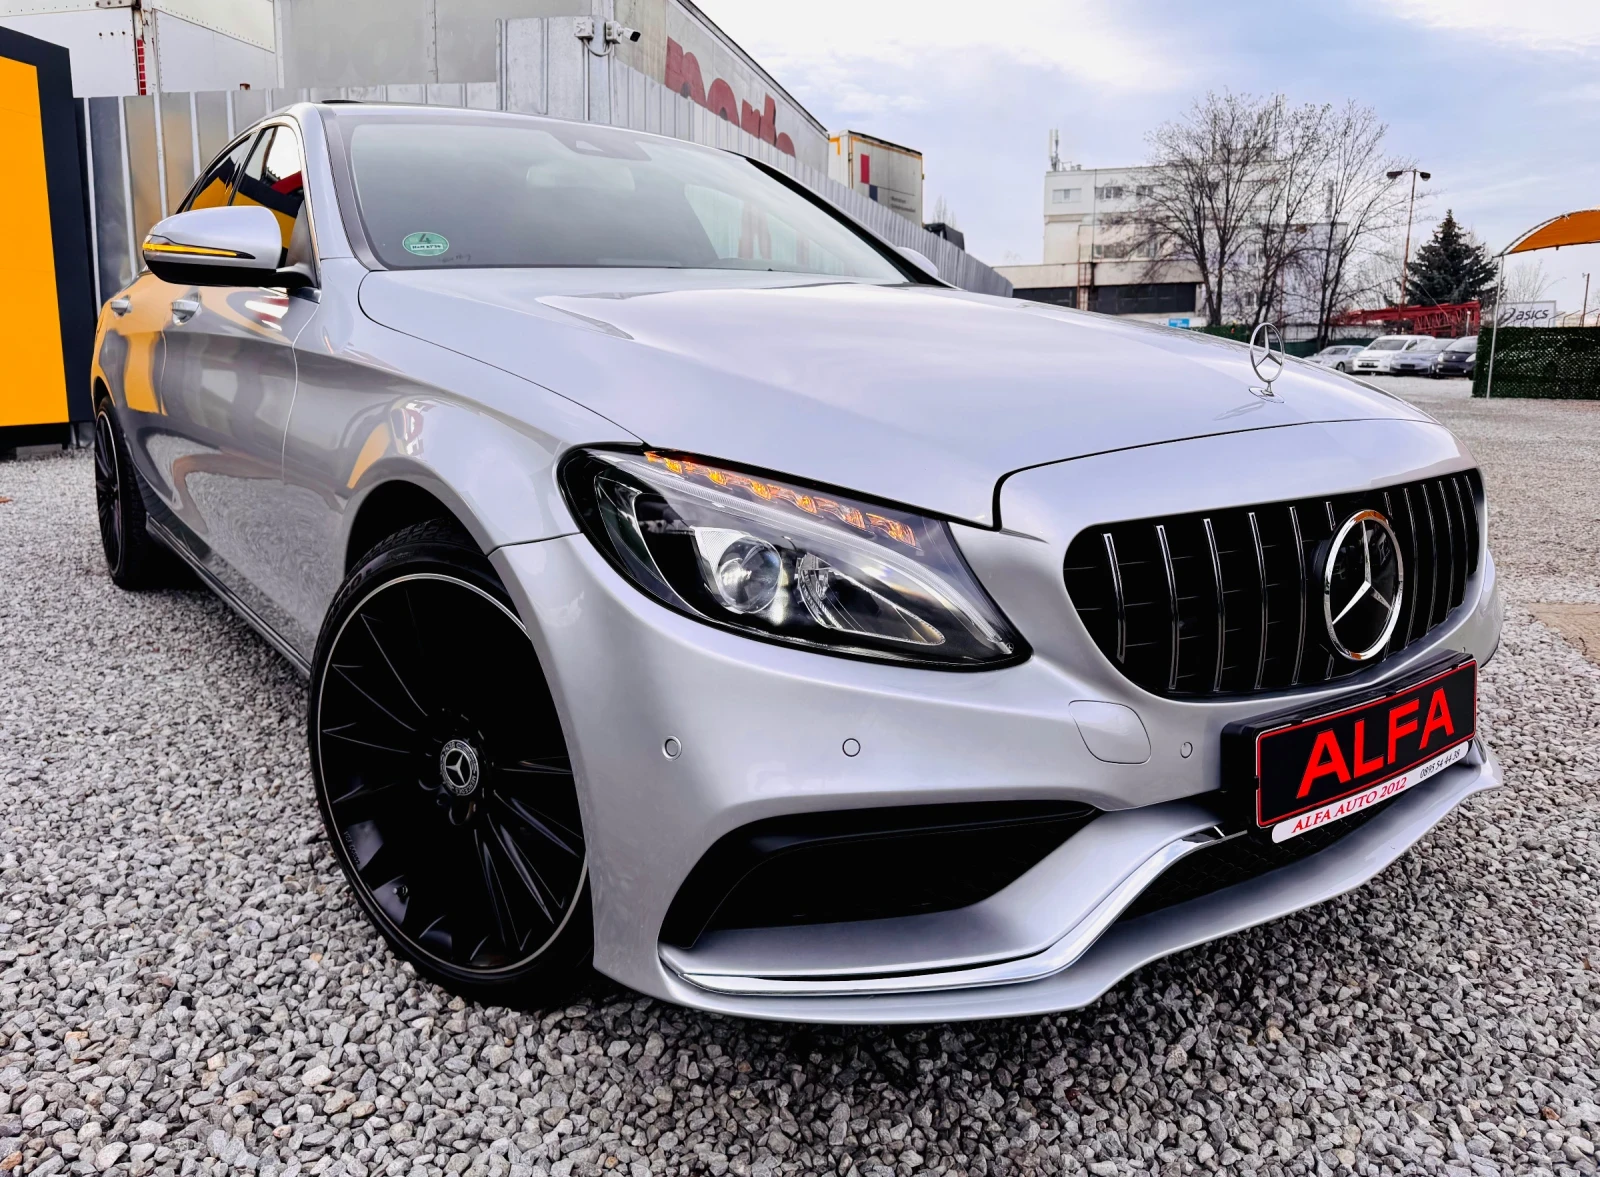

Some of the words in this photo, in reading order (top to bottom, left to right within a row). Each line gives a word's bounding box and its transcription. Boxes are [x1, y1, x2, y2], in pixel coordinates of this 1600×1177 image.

[1296, 687, 1455, 799] ALFA
[1292, 809, 1331, 833] ALFA
[1334, 792, 1377, 817] AUTO
[1379, 777, 1407, 799] 2012
